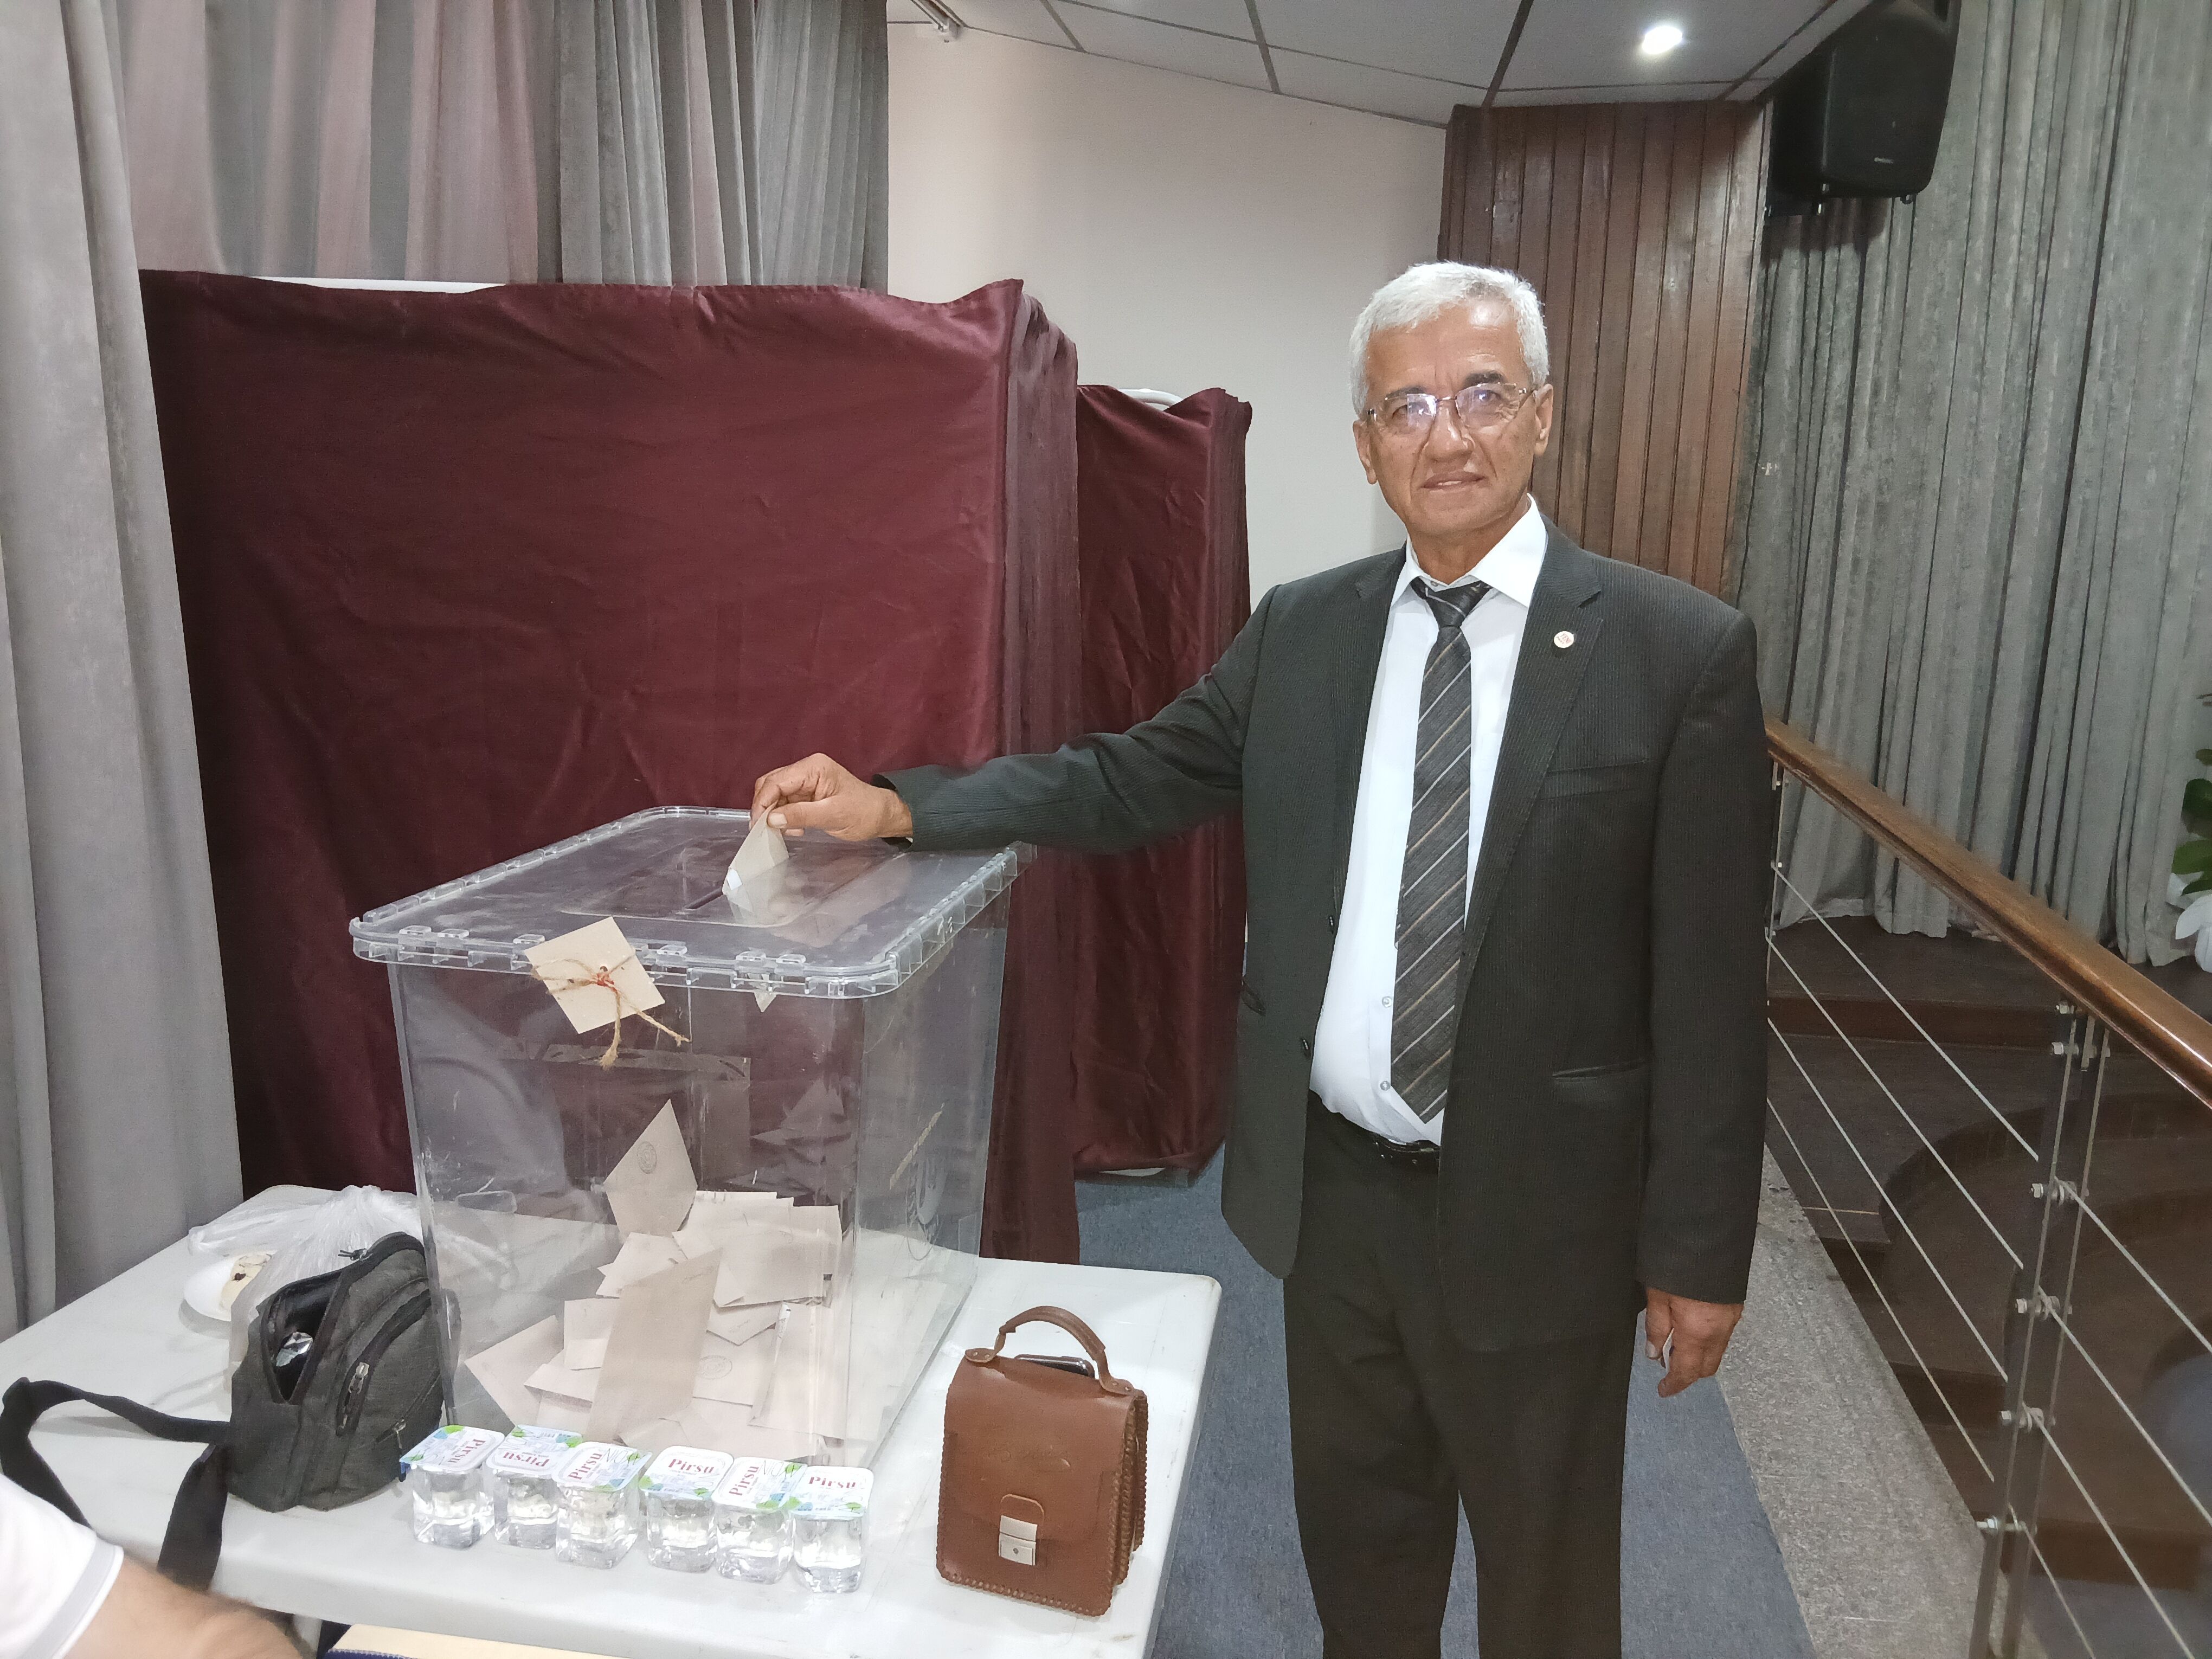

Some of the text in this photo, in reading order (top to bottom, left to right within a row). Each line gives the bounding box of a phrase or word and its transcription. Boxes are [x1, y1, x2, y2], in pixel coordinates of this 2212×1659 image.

[448, 1439, 486, 1463] Pirsu
[503, 1452, 550, 1467] Pirsu
[568, 1452, 602, 1480] Pirsu
[668, 1458, 715, 1473] Pirsu
[729, 1466, 759, 1496] Pirsu
[808, 1476, 856, 1488] Pirsu
